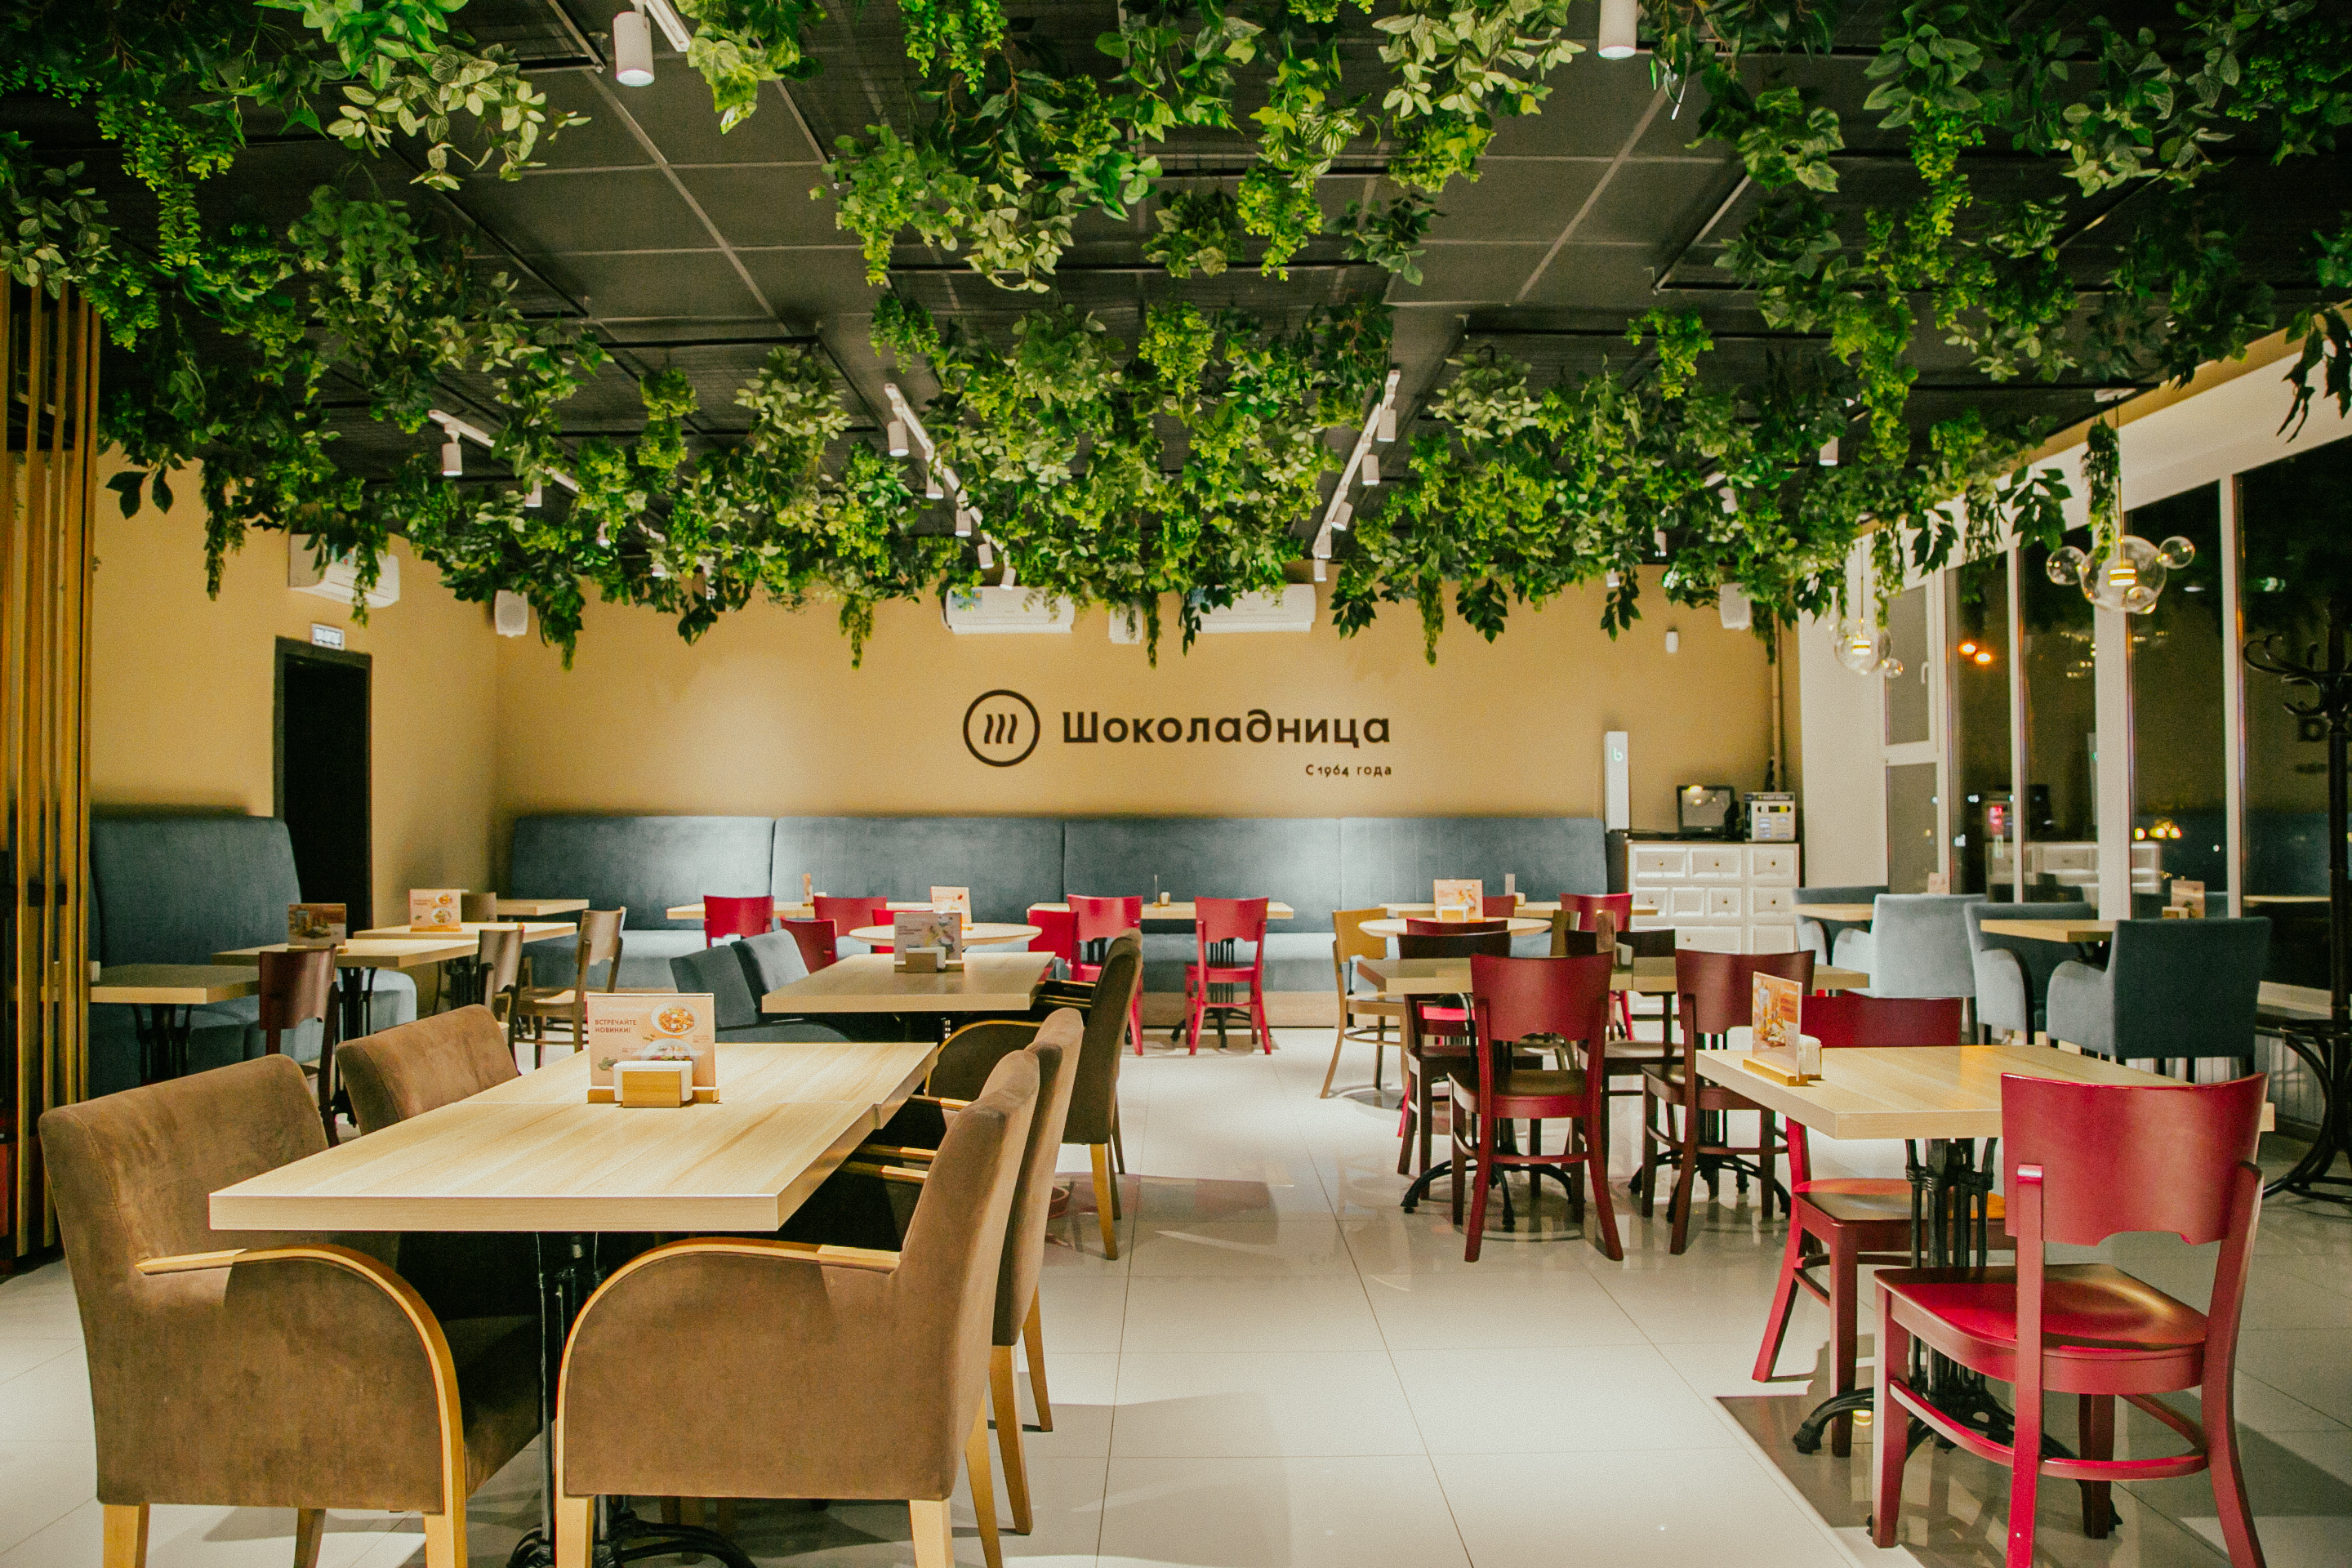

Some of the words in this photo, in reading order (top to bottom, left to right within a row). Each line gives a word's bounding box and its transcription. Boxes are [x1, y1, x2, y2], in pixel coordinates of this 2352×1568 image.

[1062, 709, 1390, 748] Шоколадница
[1318, 764, 1349, 777] 1964
[1357, 767, 1392, 777] года
